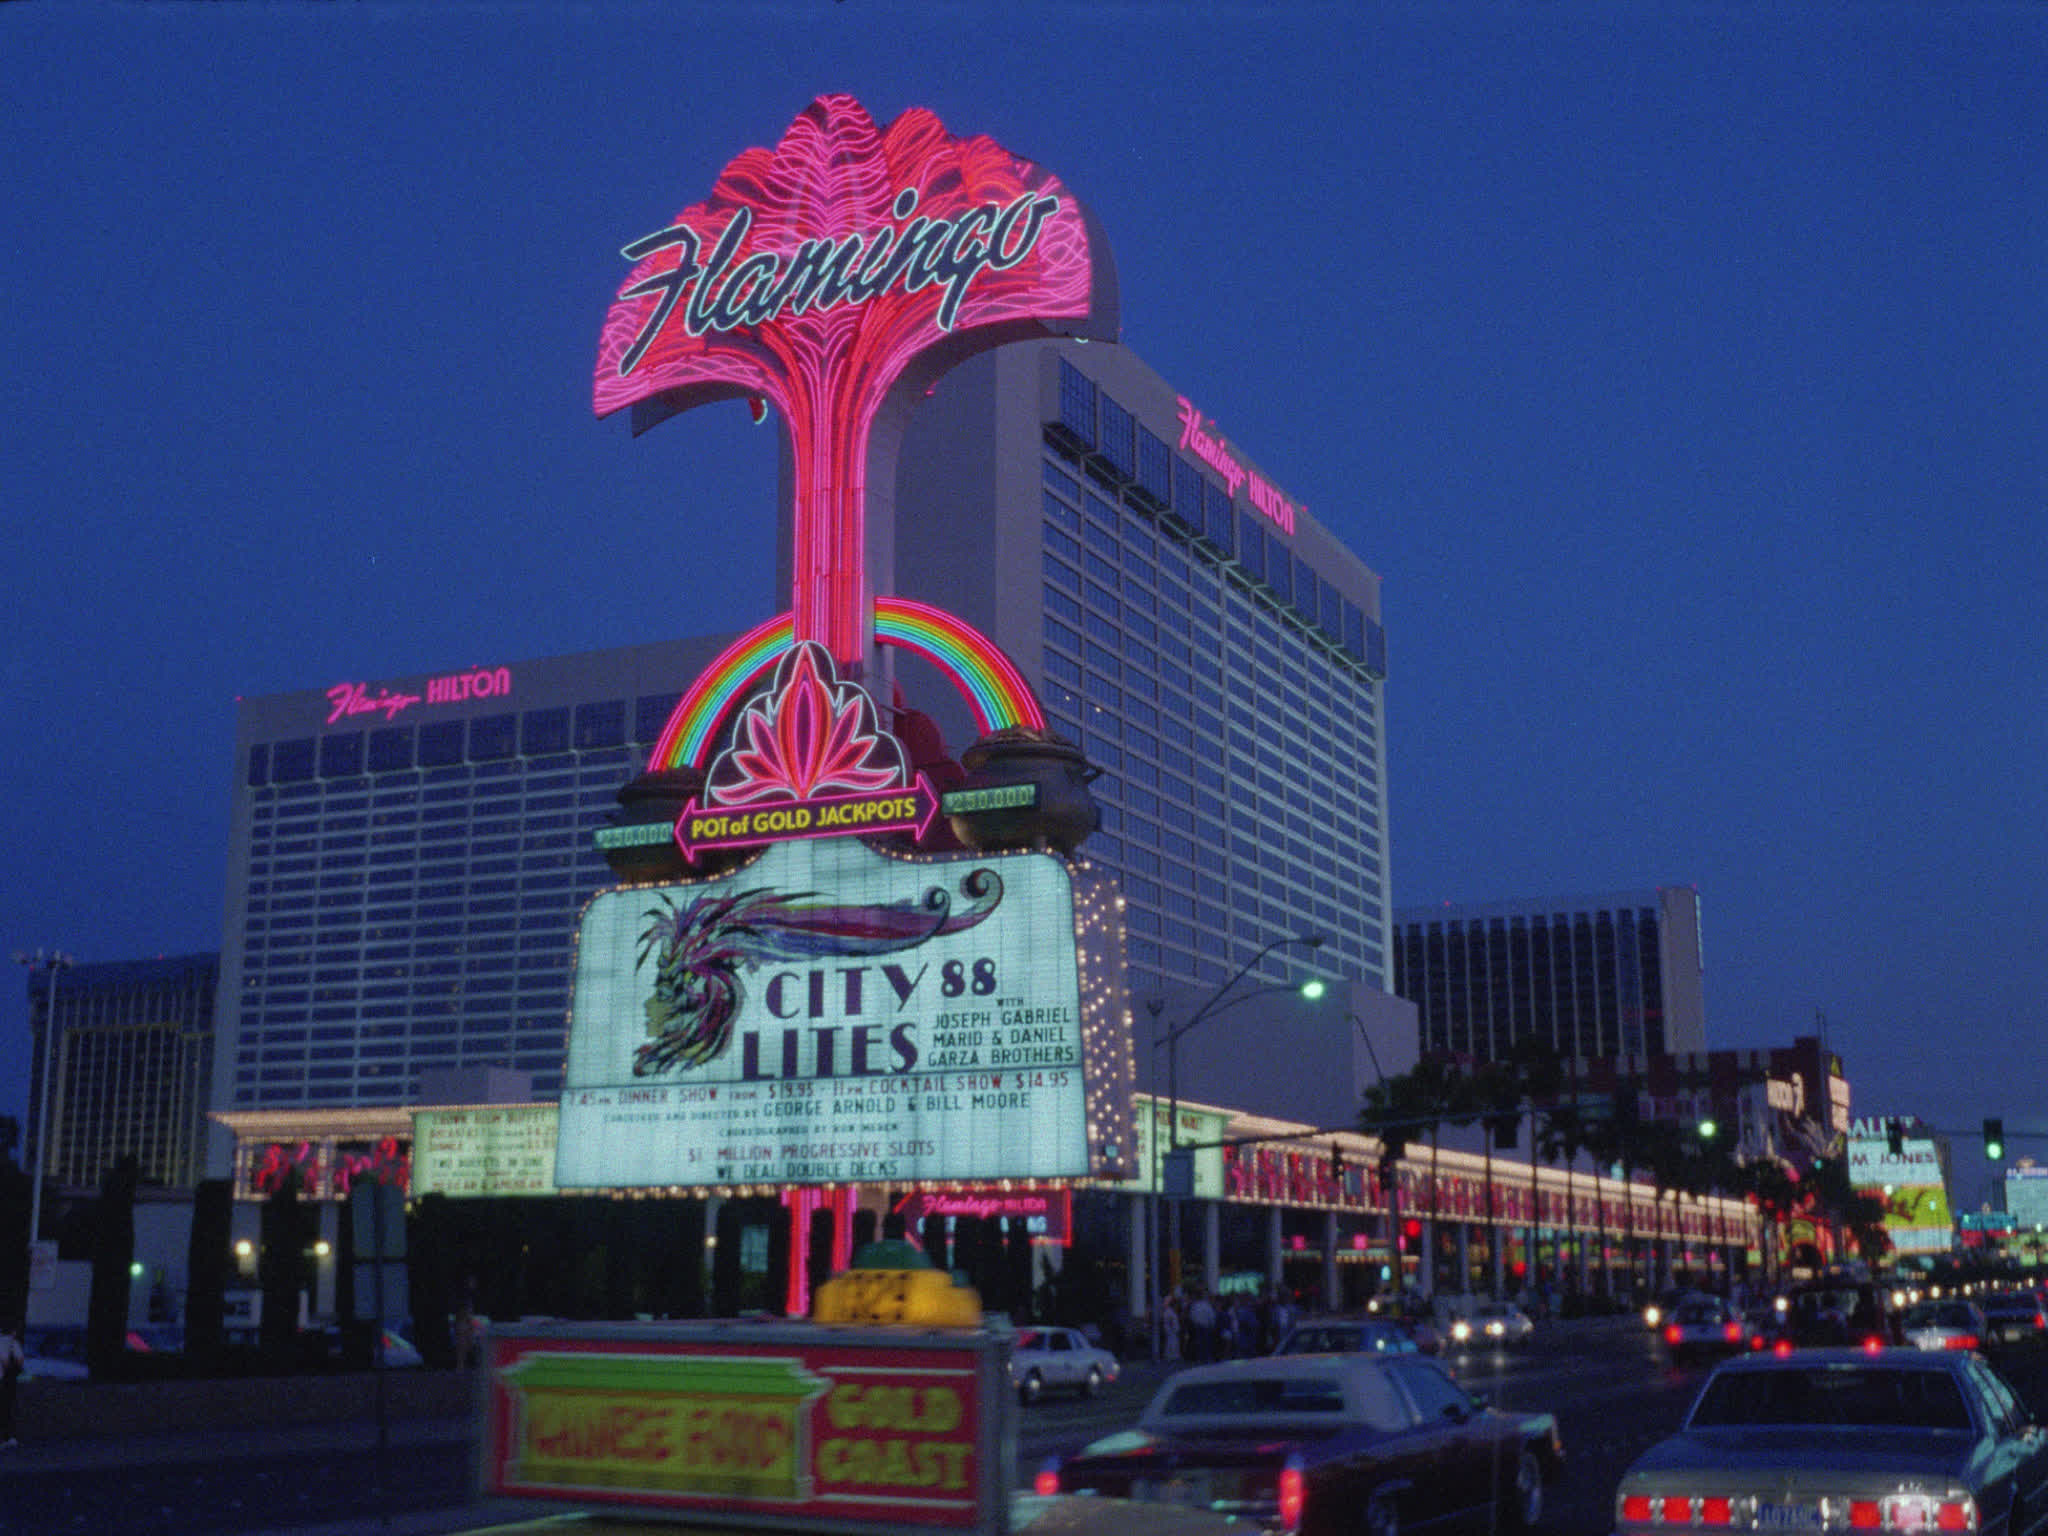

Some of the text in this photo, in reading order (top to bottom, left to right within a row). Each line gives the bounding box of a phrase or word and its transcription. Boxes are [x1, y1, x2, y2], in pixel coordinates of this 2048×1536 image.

[618, 187, 1060, 377] Flamingo
[1176, 395, 1296, 536] Flamingo HILTON
[326, 666, 511, 724] Flamingo HILTON
[691, 797, 917, 839] POT of GOLD JACKPOTS
[766, 957, 997, 1020] CITY 88
[935, 1007, 1071, 1030] JOSEPH GABRIEL
[991, 1031, 1003, 1046] &
[1010, 1027, 1067, 1045] DANIEL
[743, 1022, 919, 1081] LITES
[928, 1045, 1074, 1067] GARZA BROTHERS
[618, 1086, 669, 1106] DINNER
[679, 1085, 718, 1104] SHOW
[869, 1076, 947, 1096] COCKTAIL
[956, 1074, 1003, 1092] SHOW
[763, 1101, 822, 1117] GEORGE
[833, 1097, 896, 1115] ARNOLD
[926, 1095, 961, 1112] BILL
[971, 1092, 1031, 1110] MOORE
[717, 1143, 773, 1161] MILLION
[781, 1142, 881, 1160] PROGRESSIVE
[887, 1140, 936, 1157] SLOTS
[743, 1162, 777, 1178] DEAL
[786, 1161, 841, 1178] DOUBLE
[849, 1160, 898, 1177] DECKS
[828, 1382, 964, 1433] GOLD
[817, 1437, 975, 1491] COAST
